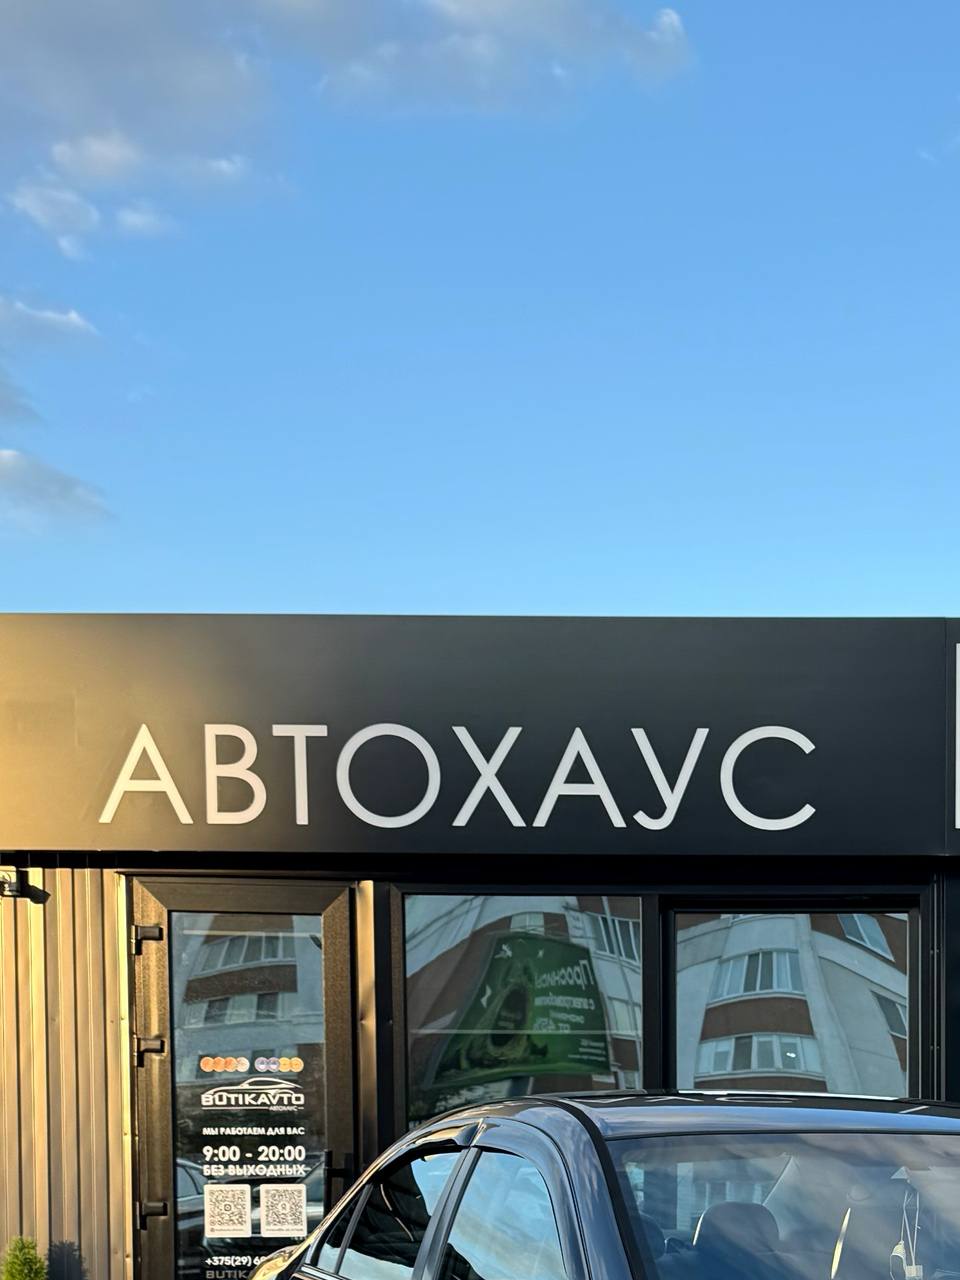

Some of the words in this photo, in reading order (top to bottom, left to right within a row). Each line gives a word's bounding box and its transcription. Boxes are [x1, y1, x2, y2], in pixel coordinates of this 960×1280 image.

[98, 722, 817, 830] АВТОХАУС
[201, 1093, 305, 1106] BUTIKAVTO
[202, 1127, 218, 1136] МЫ
[220, 1127, 266, 1136] РАБОТАЕМ
[267, 1127, 286, 1136] ДЛЯ
[287, 1127, 305, 1135] ВАС
[202, 1145, 241, 1162] 9:00
[257, 1145, 306, 1162] 20:00
[202, 1164, 225, 1177] БЕЗ
[228, 1163, 306, 1177] ВЫХОДНЫХ
[205, 1256, 252, 1267] +375(29)
[205, 1270, 248, 1279] BUTIK
